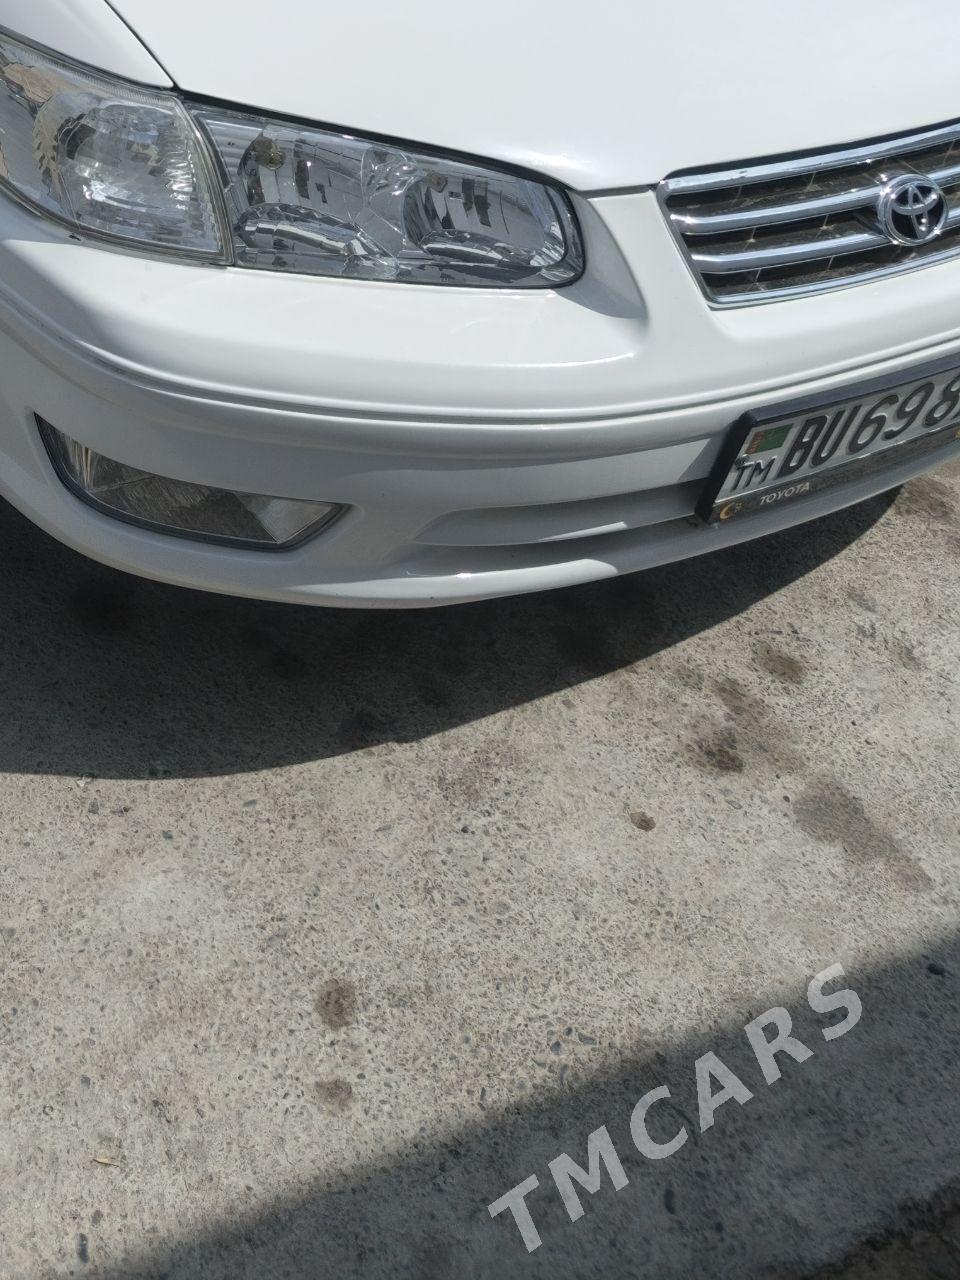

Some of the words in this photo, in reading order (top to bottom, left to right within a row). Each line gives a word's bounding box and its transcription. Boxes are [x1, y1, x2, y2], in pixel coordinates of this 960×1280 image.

[730, 455, 778, 492] TM
[775, 372, 960, 478] BU698
[759, 481, 811, 505] TOYOTA
